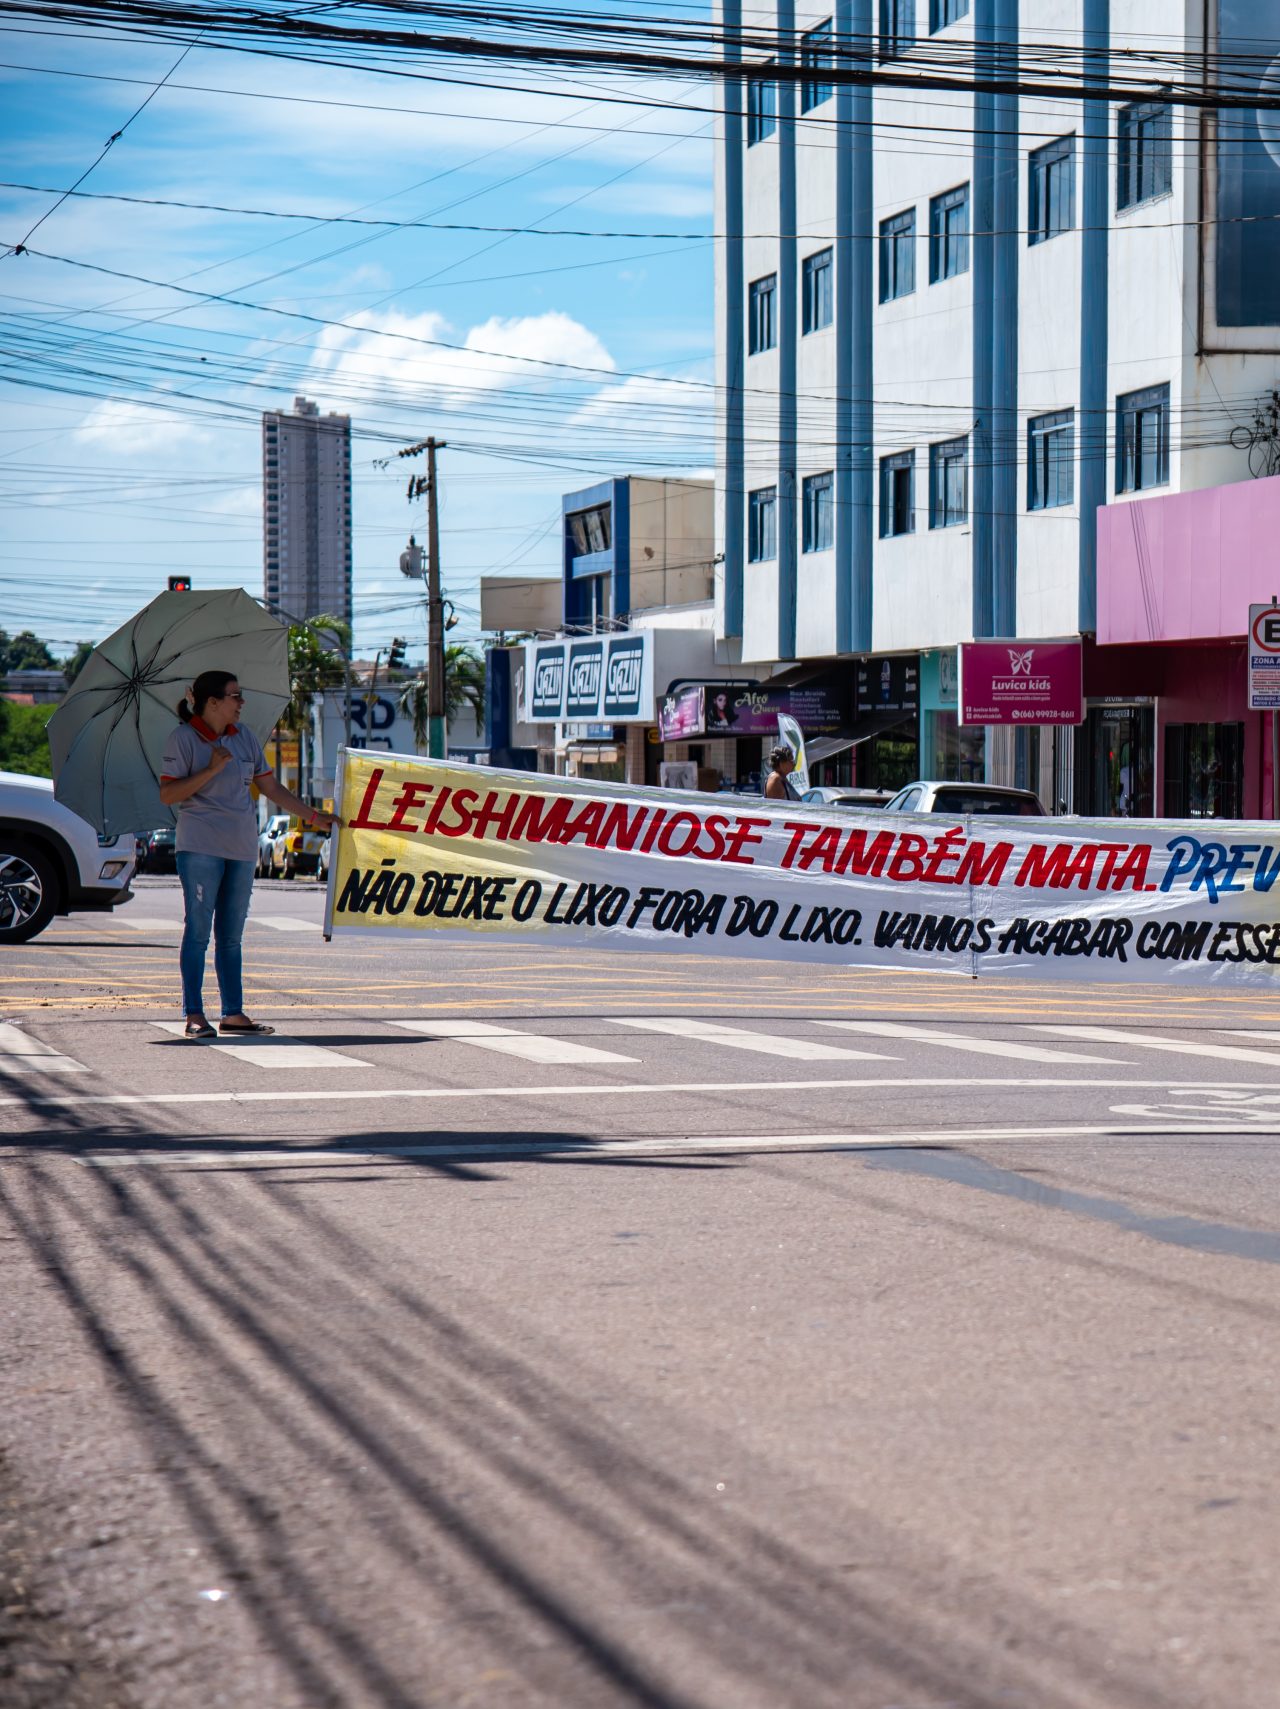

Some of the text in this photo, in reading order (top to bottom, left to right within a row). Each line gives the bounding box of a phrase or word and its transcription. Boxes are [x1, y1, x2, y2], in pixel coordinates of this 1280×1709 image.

[568, 654, 602, 705] GAZIN
[606, 650, 642, 704] GAZIN
[992, 680, 1051, 690] Luvica kids
[348, 768, 771, 865] LEISHMANIOSE
[780, 825, 1014, 887] TAMBÉM
[1014, 843, 1157, 892] MATA.
[336, 858, 416, 916] NÃO
[413, 870, 517, 921] DEIXE
[511, 880, 543, 922] O
[543, 883, 631, 927] LIXO
[626, 887, 728, 938] FORA
[725, 895, 779, 937] DO
[778, 904, 862, 945] LIXO.
[873, 910, 996, 953] VAMOS
[998, 917, 1134, 963] ACABAR
[1136, 921, 1213, 961] COM
